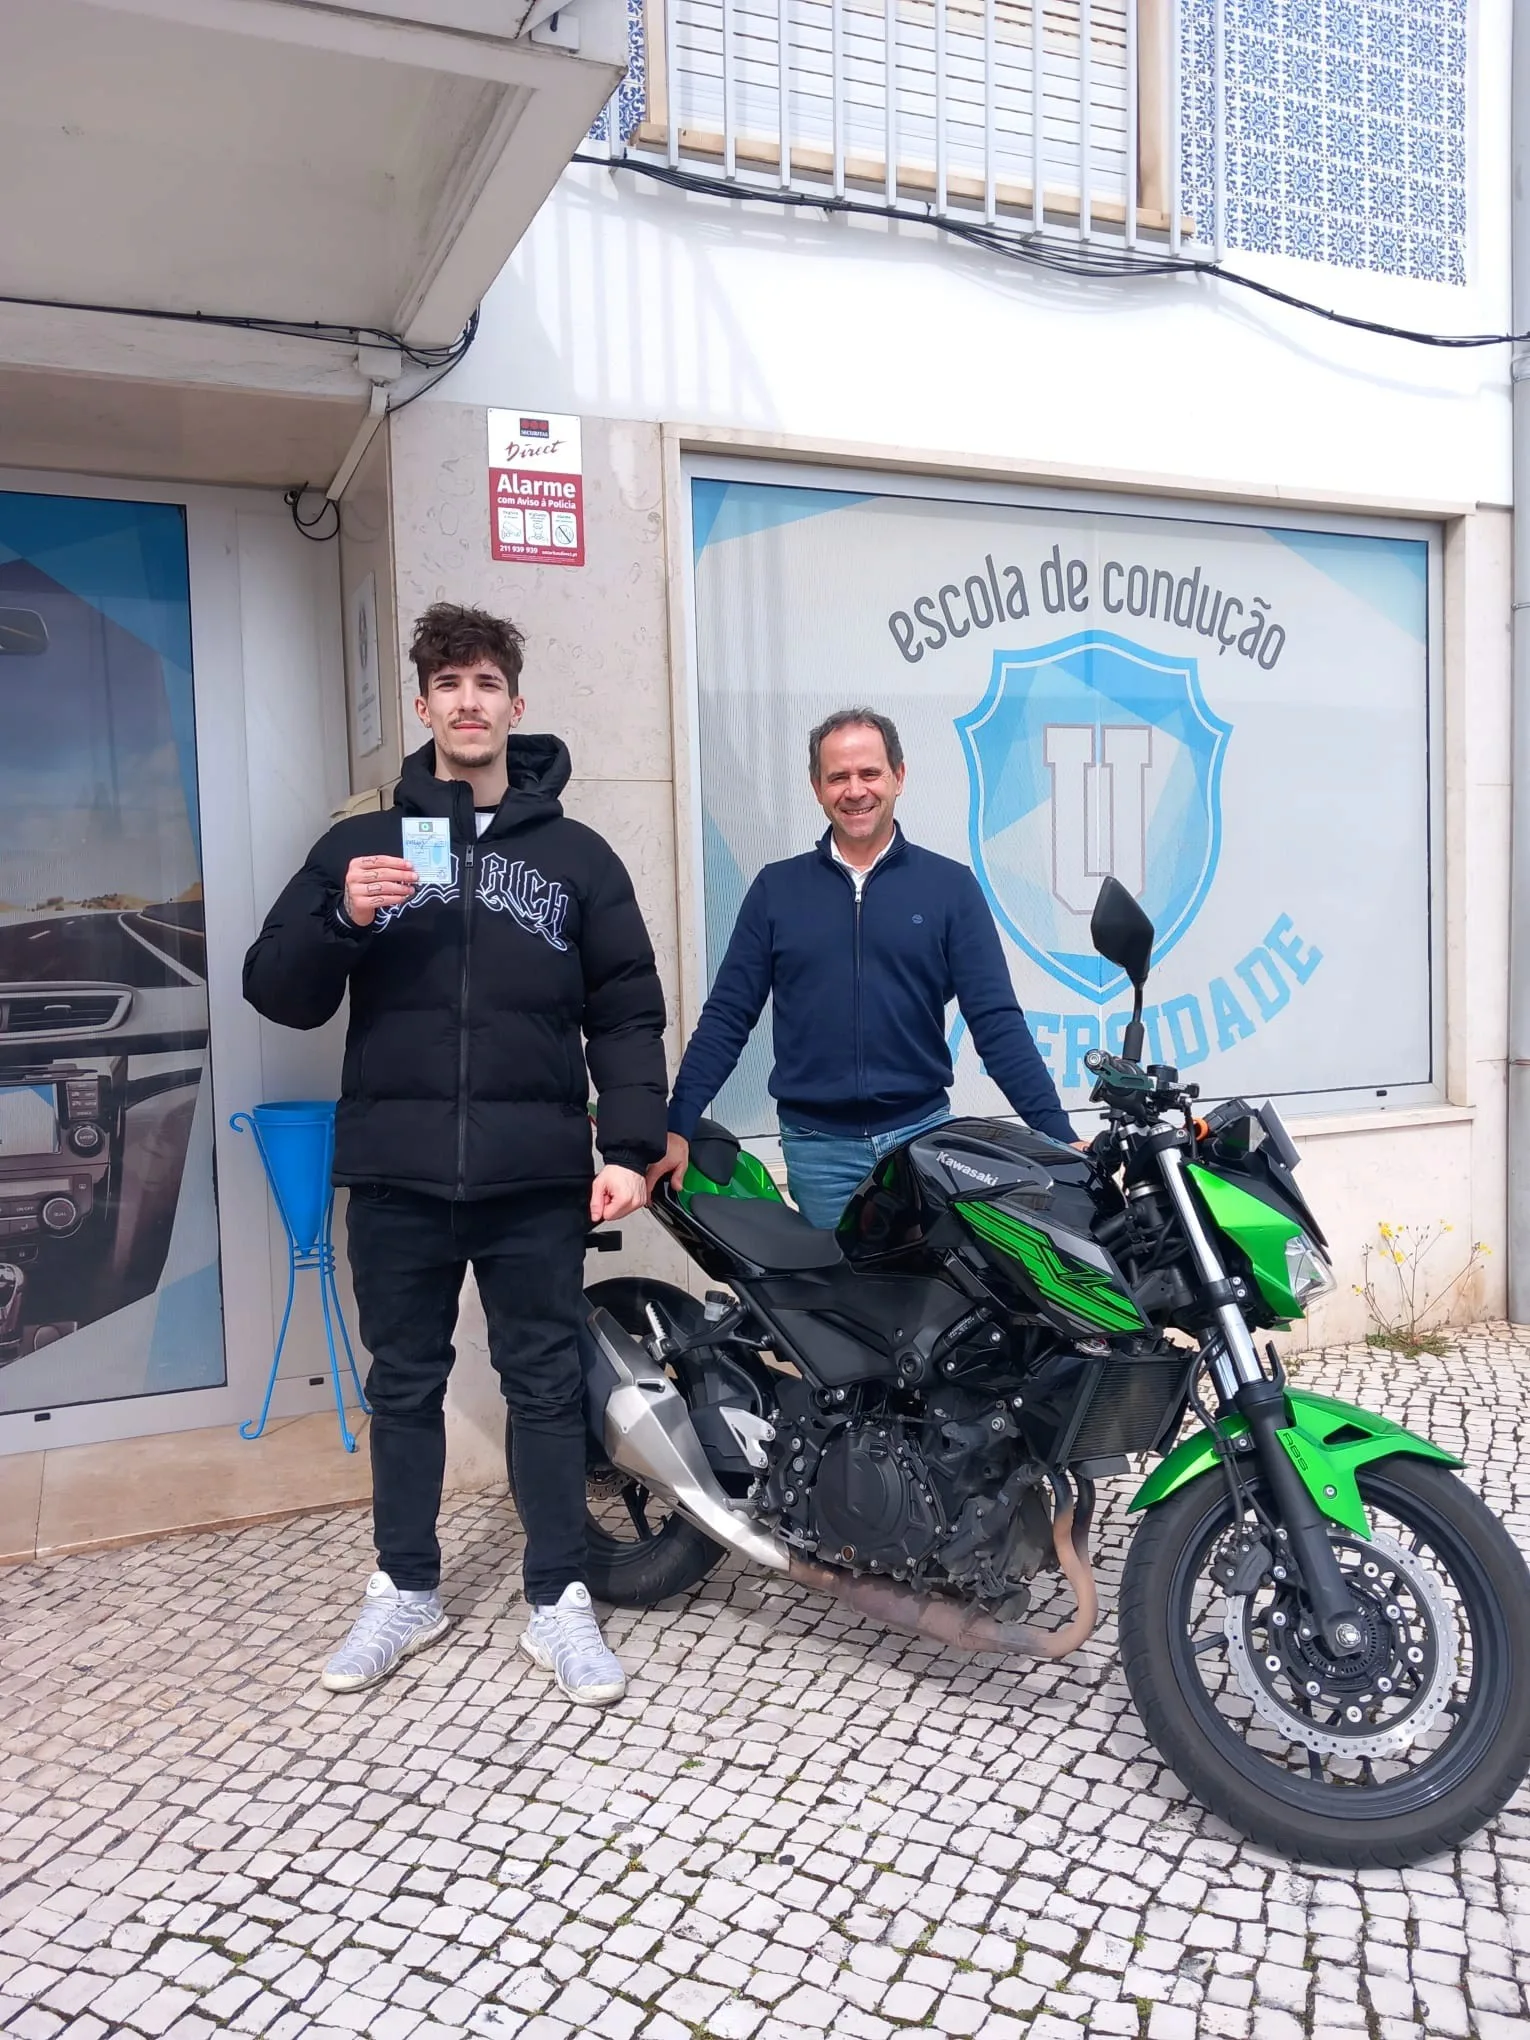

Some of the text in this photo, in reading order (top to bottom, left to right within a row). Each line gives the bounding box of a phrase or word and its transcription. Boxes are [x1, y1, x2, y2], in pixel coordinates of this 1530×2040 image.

[504, 440, 567, 462] Direct
[497, 473, 576, 498] Alarme
[497, 496, 576, 509] com Aviso à Polícia
[888, 544, 1288, 671] escola de condução
[1043, 724, 1153, 915] U
[480, 852, 568, 938] RICH
[936, 1151, 999, 1187] Kawasaki
[1283, 1432, 1308, 1472] ABS
